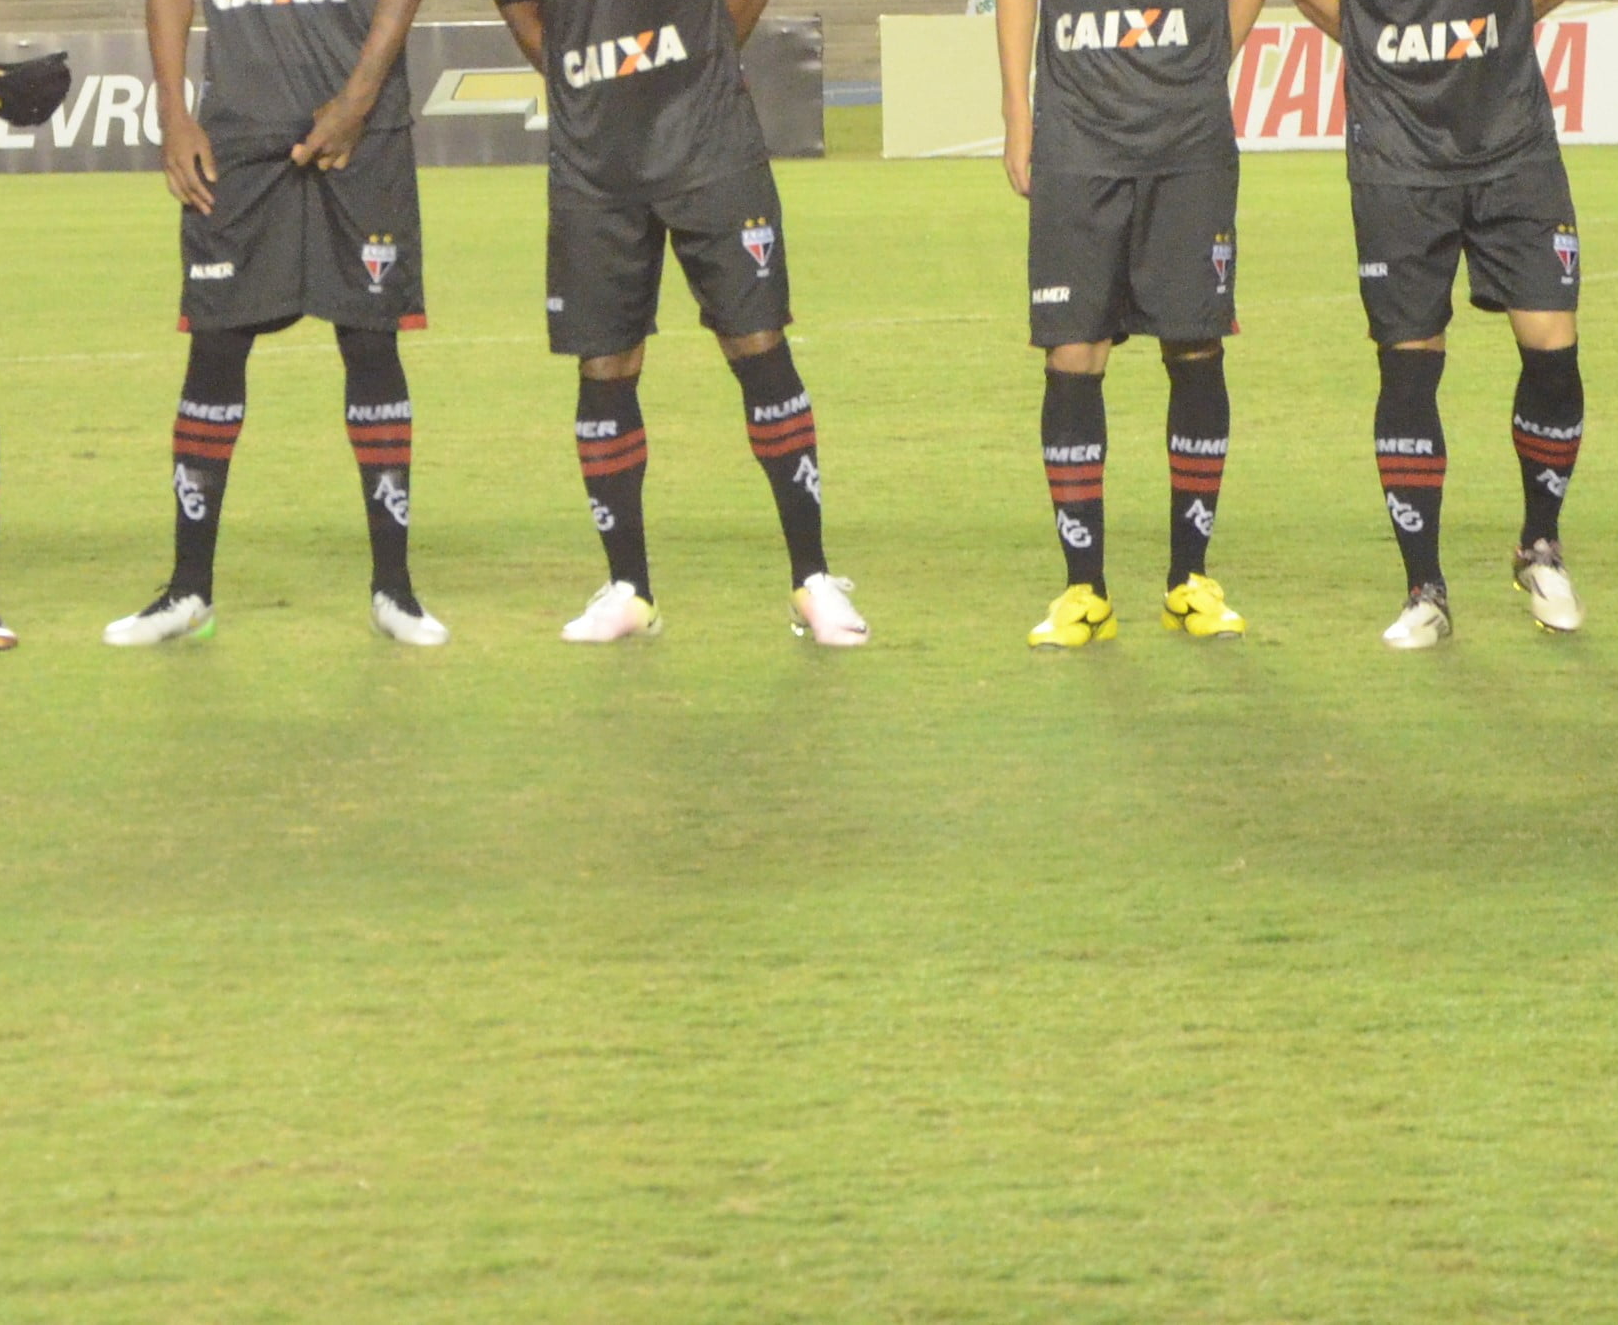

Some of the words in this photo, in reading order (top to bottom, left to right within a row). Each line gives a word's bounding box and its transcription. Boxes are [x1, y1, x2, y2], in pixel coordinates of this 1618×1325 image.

[1055, 7, 1188, 52] CAIXA
[1376, 12, 1499, 64] CAIXA
[563, 24, 687, 89] CAIXA
